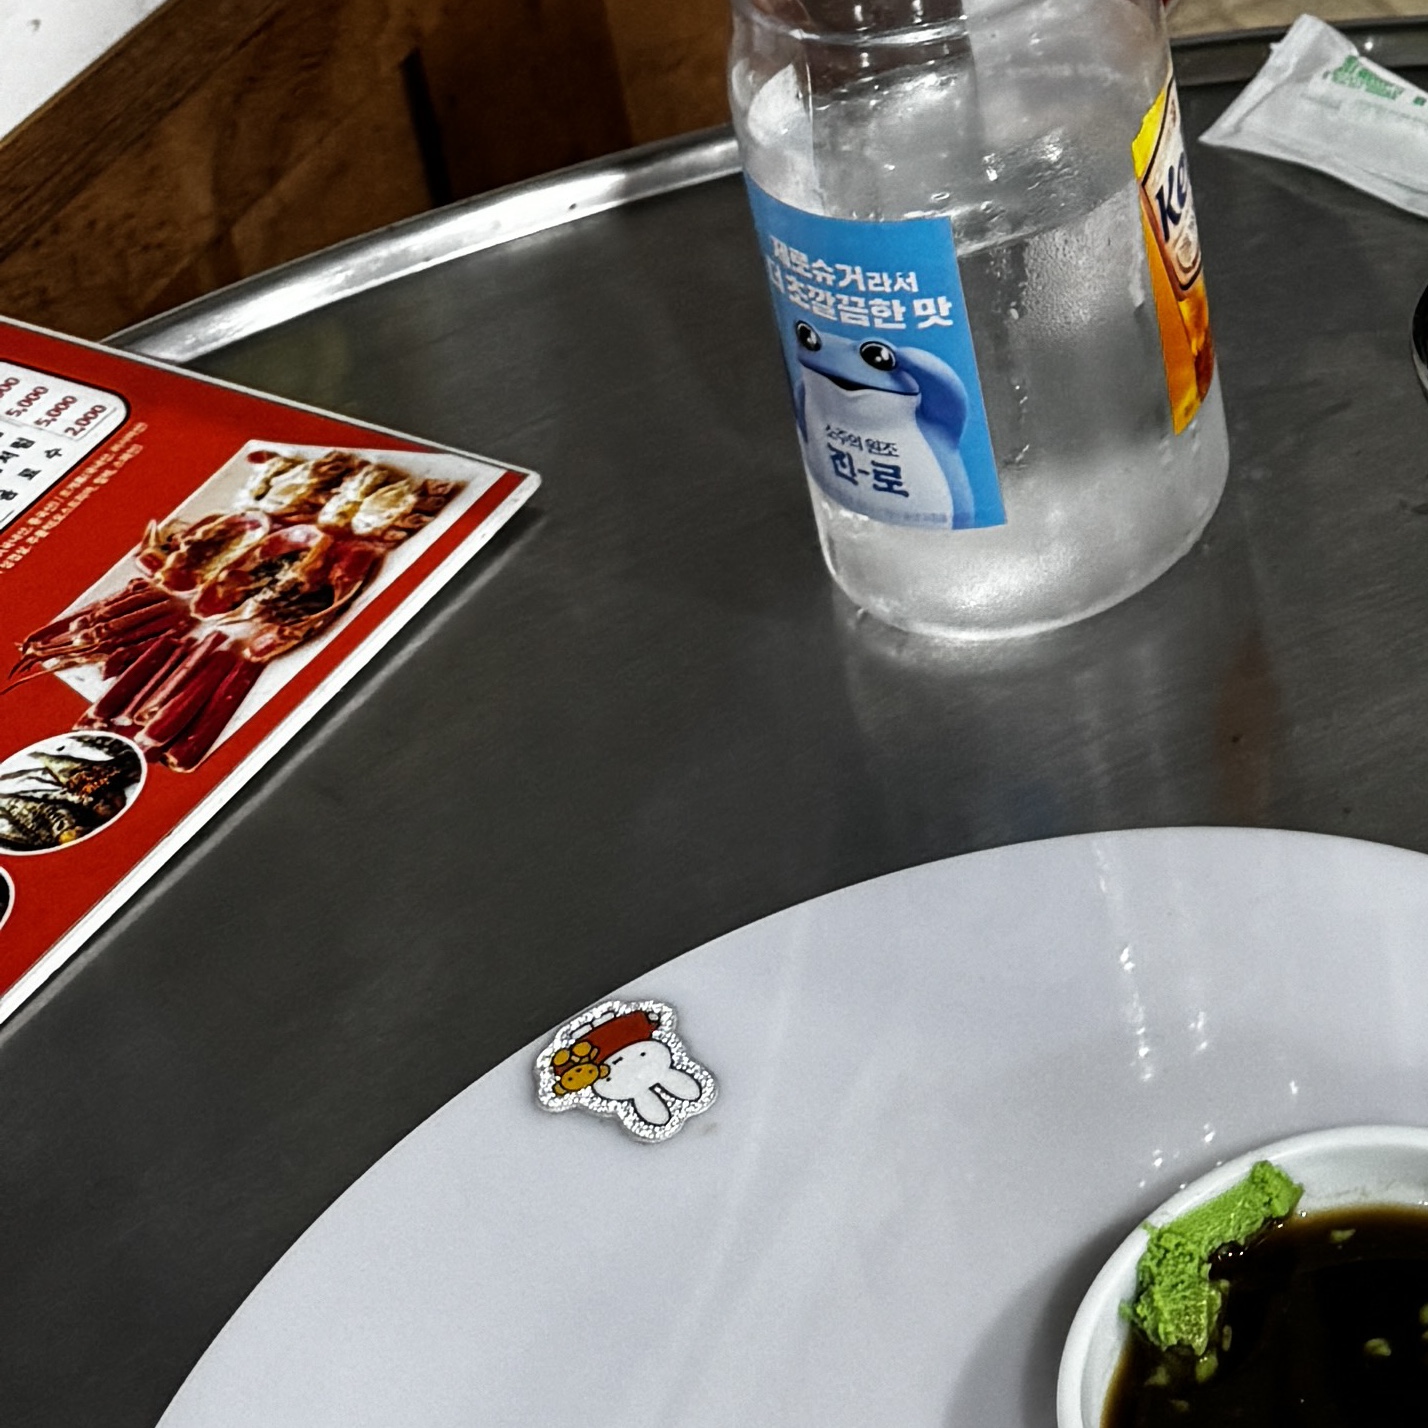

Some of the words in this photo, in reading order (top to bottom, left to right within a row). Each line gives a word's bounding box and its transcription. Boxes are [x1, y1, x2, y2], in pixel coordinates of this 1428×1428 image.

[770, 235, 919, 293] 제로슈거라서
[913, 295, 953, 329] 맛
[6, 386, 48, 417] 5,000
[34, 395, 78, 428] 5,000
[65, 404, 107, 436] 2,000
